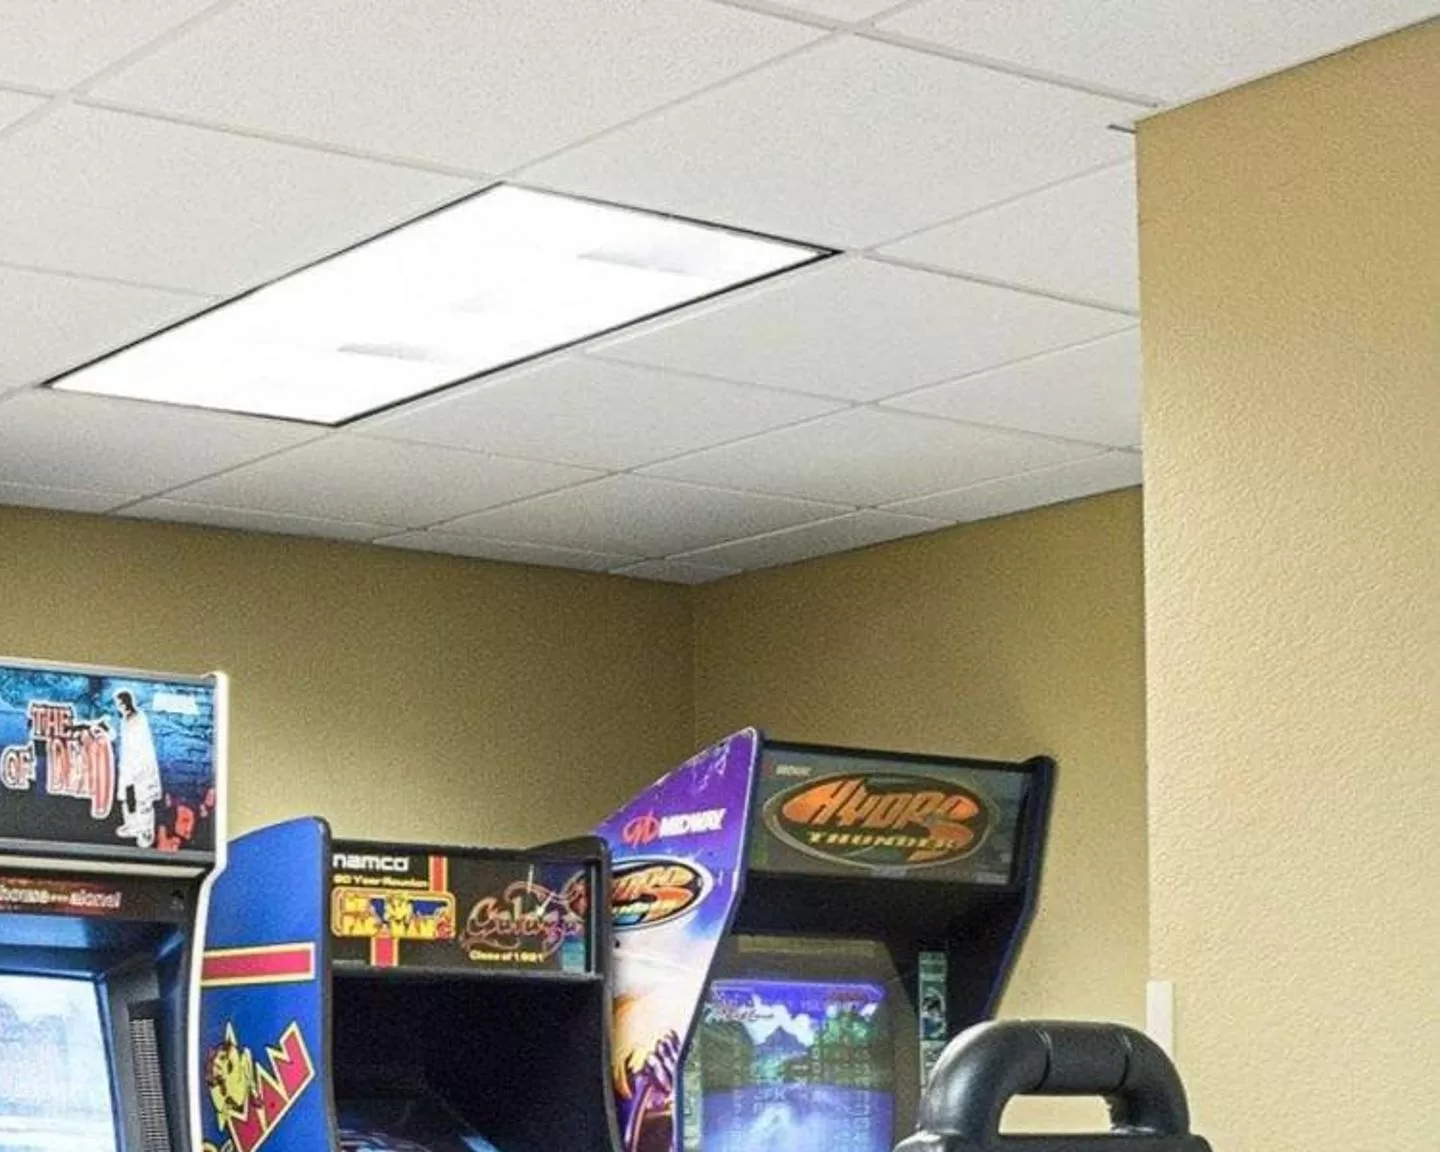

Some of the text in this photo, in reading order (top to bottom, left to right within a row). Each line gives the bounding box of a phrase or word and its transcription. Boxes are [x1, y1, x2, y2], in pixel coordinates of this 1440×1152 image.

[28, 700, 75, 739] THE
[0, 742, 36, 789] OF
[333, 853, 410, 872] namco
